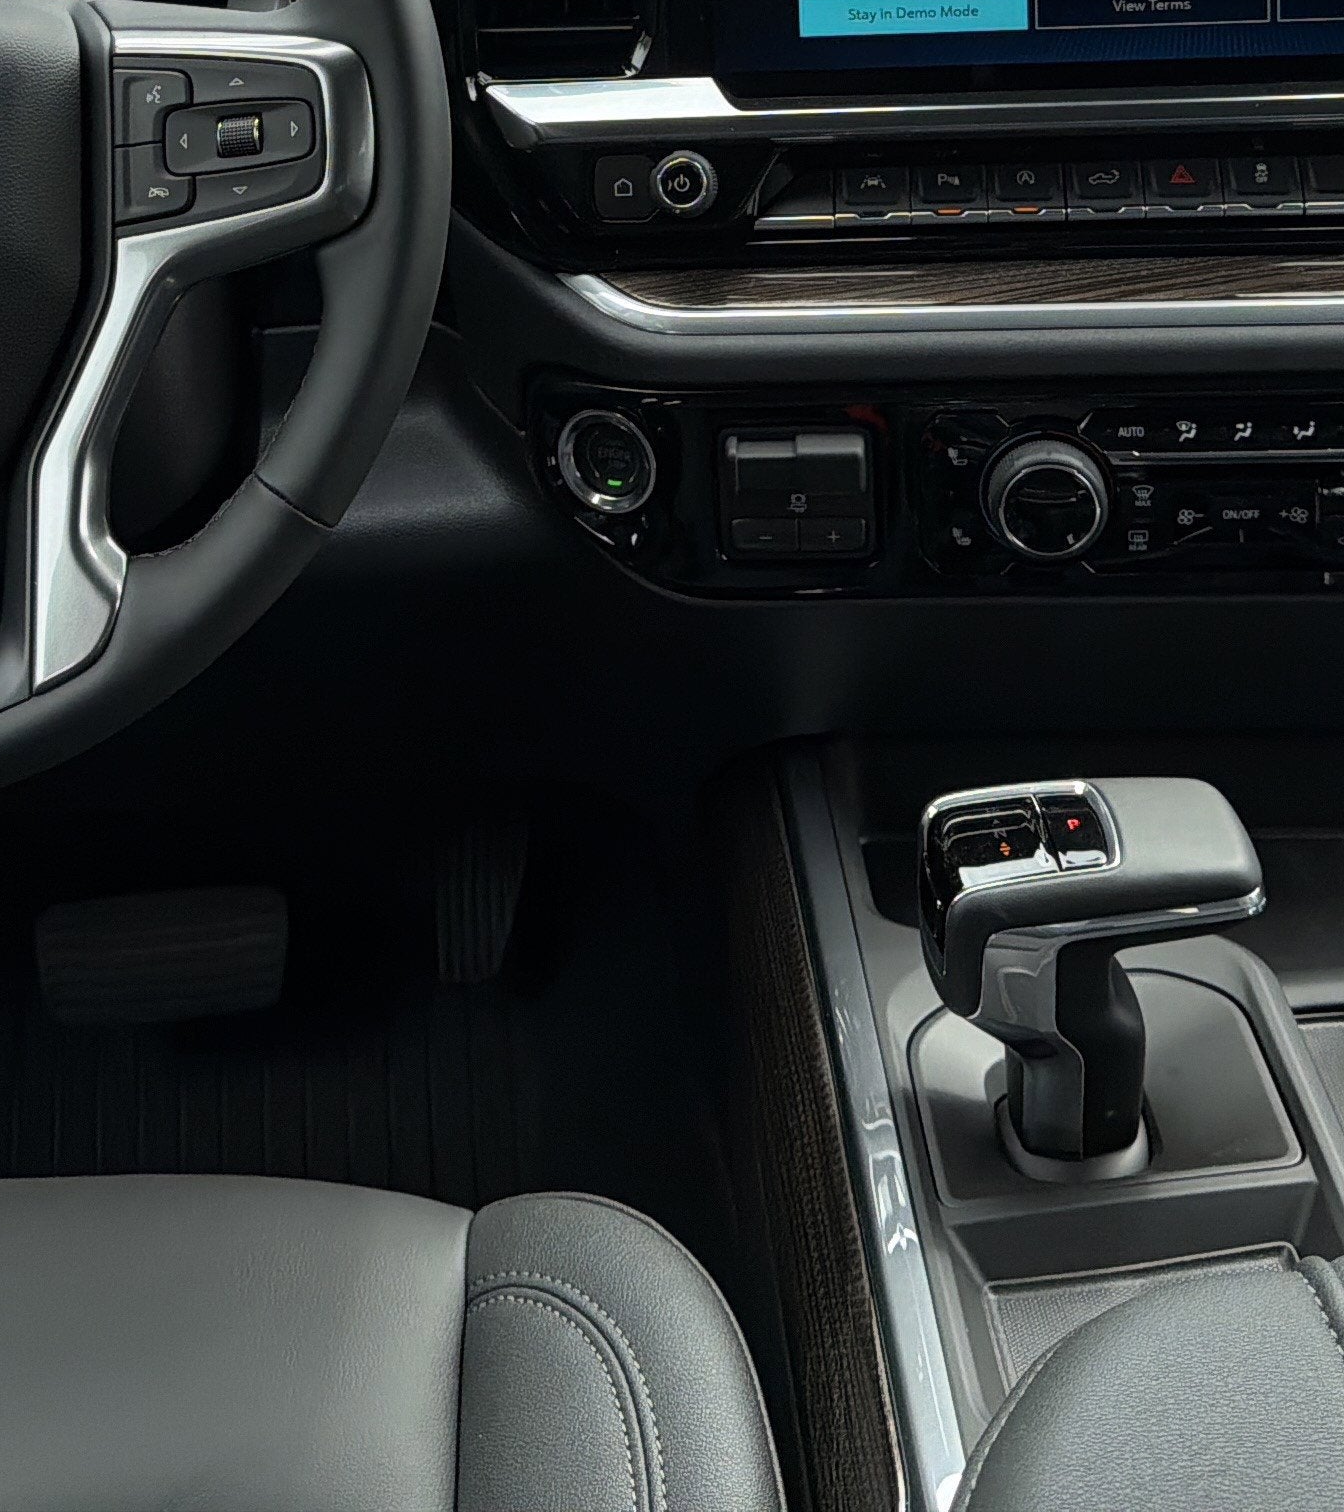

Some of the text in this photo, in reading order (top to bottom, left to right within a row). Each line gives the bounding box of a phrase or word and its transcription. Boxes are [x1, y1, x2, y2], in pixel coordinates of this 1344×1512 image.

[848, 4, 979, 23] Stay in Demo Mode
[1117, 427, 1145, 438] AUTO
[1222, 509, 1260, 520] ON/OFF
